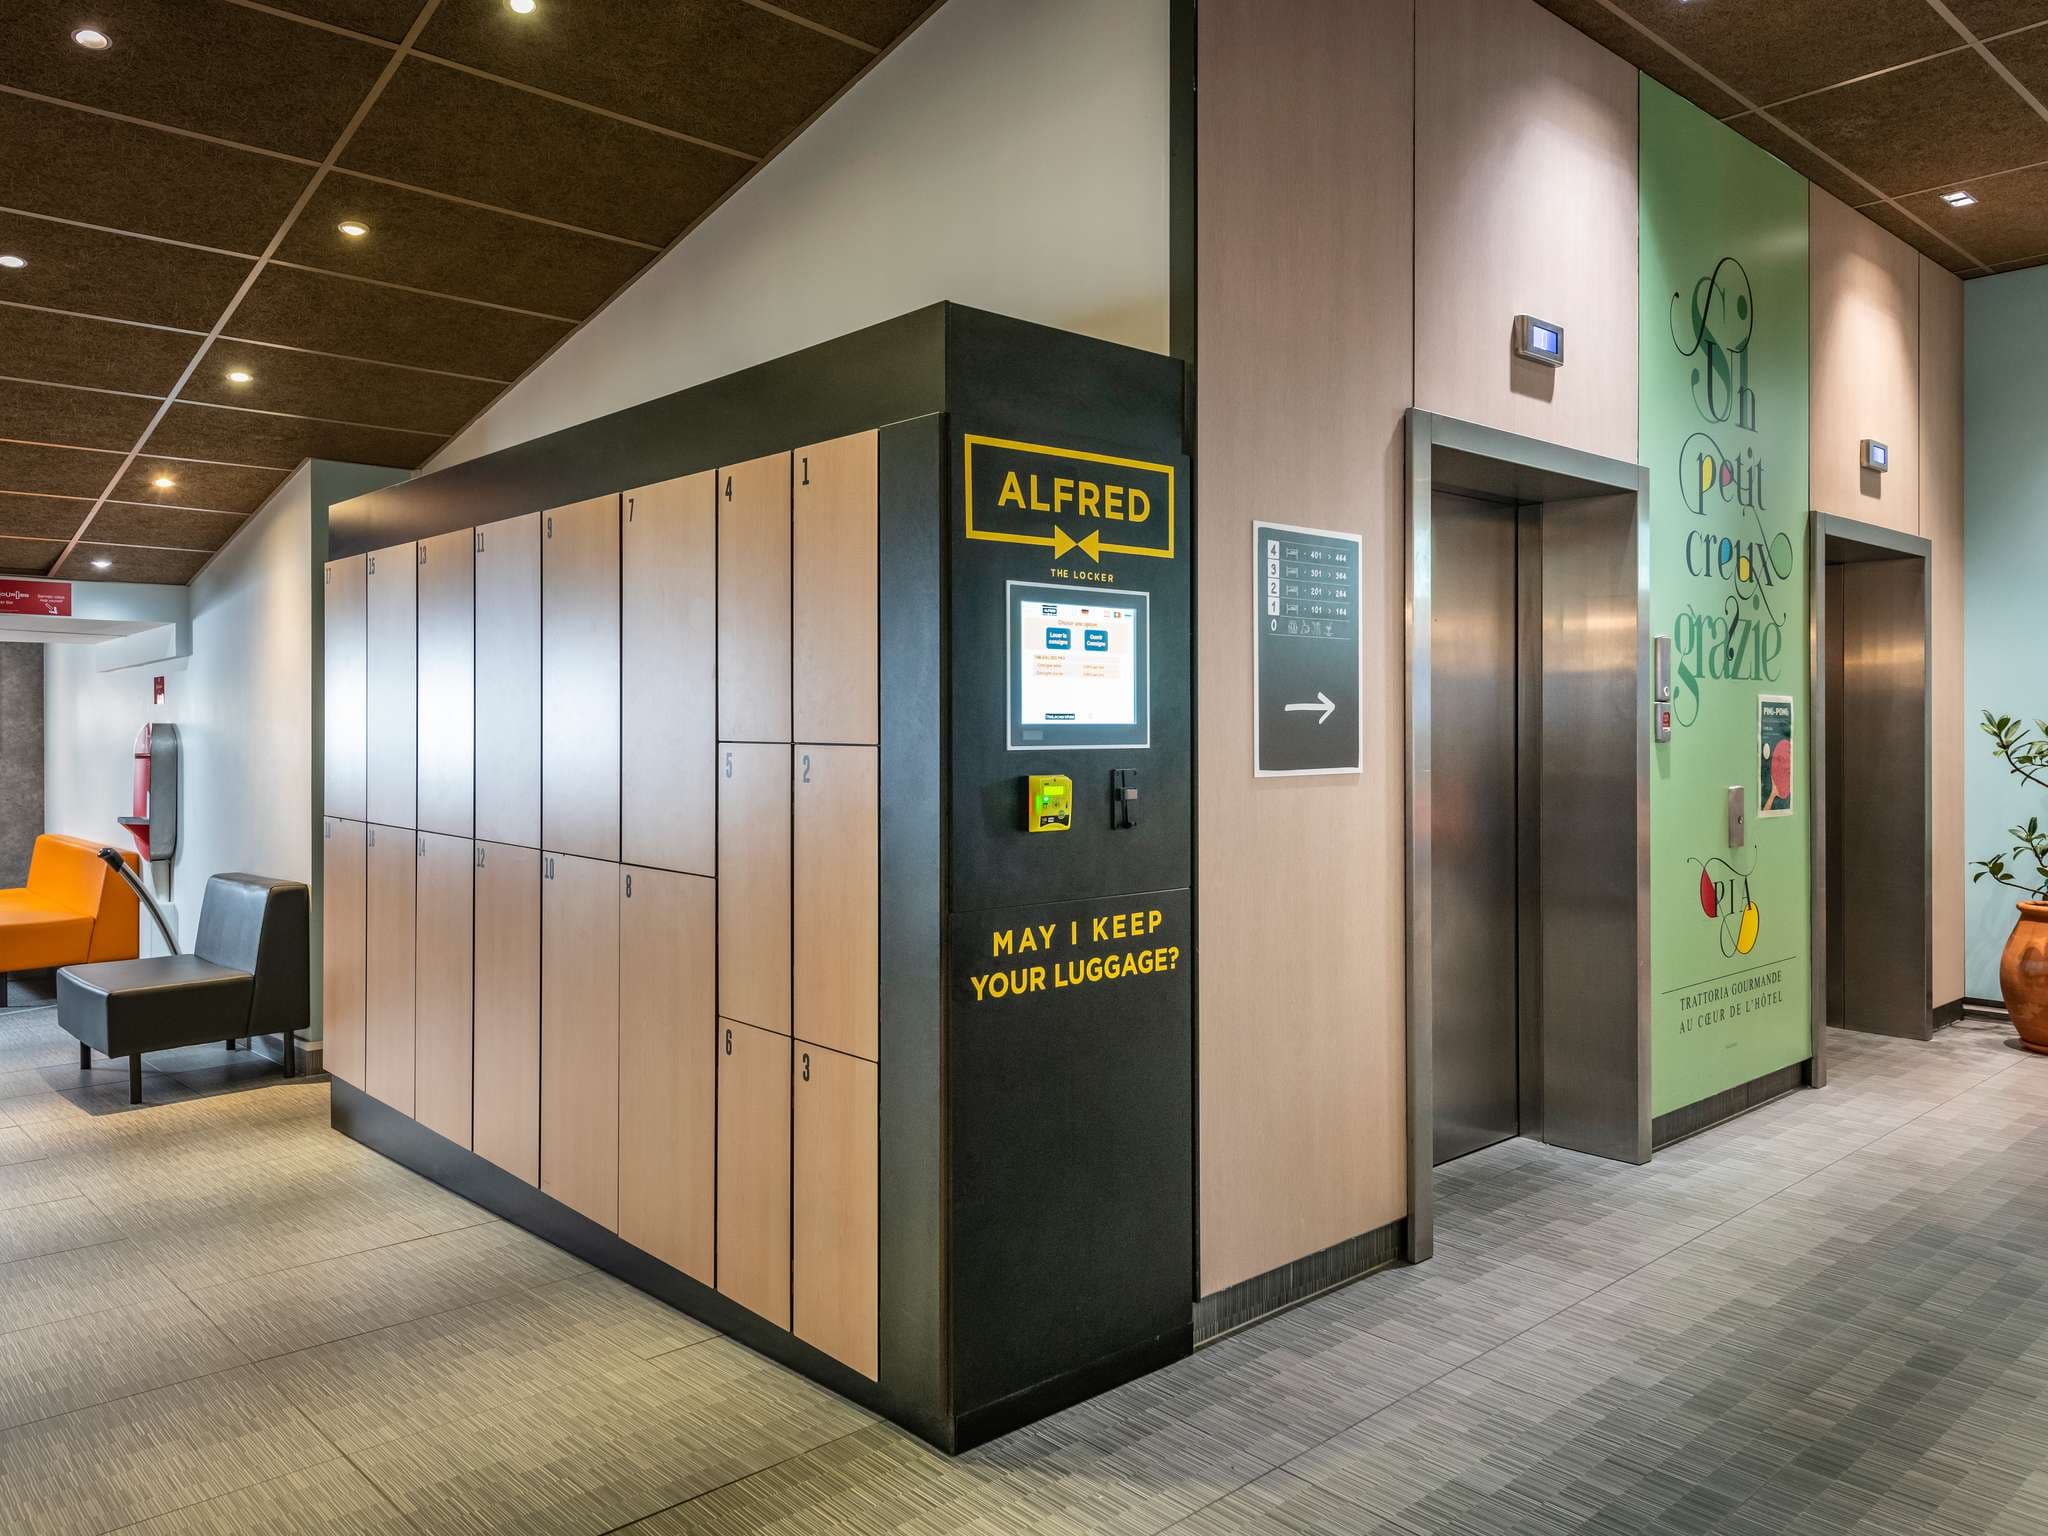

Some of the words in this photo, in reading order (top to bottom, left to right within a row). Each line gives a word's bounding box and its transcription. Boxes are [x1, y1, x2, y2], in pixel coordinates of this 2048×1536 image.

[801, 457, 810, 486] 1
[1679, 432, 1767, 516] petit
[725, 476, 733, 502] 4
[997, 471, 1151, 523] ALFRED
[628, 498, 635, 522] 7
[547, 517, 553, 539] 9
[476, 532, 485, 553] 11
[1270, 544, 1277, 556] 4
[368, 557, 376, 576] 15
[419, 545, 427, 565] 13
[1050, 567, 1069, 579] THE
[1073, 569, 1115, 583] LOCKER
[1270, 563, 1277, 575] 3
[1270, 582, 1277, 594] 2
[1271, 600, 1277, 613] 1
[1310, 605, 1322, 614] 101
[1270, 619, 1277, 632] 0
[1673, 594, 1782, 727] grazie
[725, 752, 733, 779] 5
[802, 754, 811, 784] 2
[476, 847, 486, 869] 12
[544, 857, 555, 881] 10
[625, 874, 633, 898] 8
[992, 923, 1057, 958] MAY
[1071, 921, 1078, 946] I
[1093, 910, 1163, 942] KEEP
[970, 966, 1047, 1002] YOUR
[1054, 946, 1180, 989] LUGGAGE?
[1679, 985, 1729, 1011] TRATTORIA
[1731, 970, 1782, 996] GOURMANDE
[1679, 1018, 1694, 1035] AU
[1697, 1008, 1726, 1029] CŒUR
[1729, 1003, 1742, 1018] DE
[725, 1028, 733, 1056] 6
[802, 1052, 811, 1082] 3
